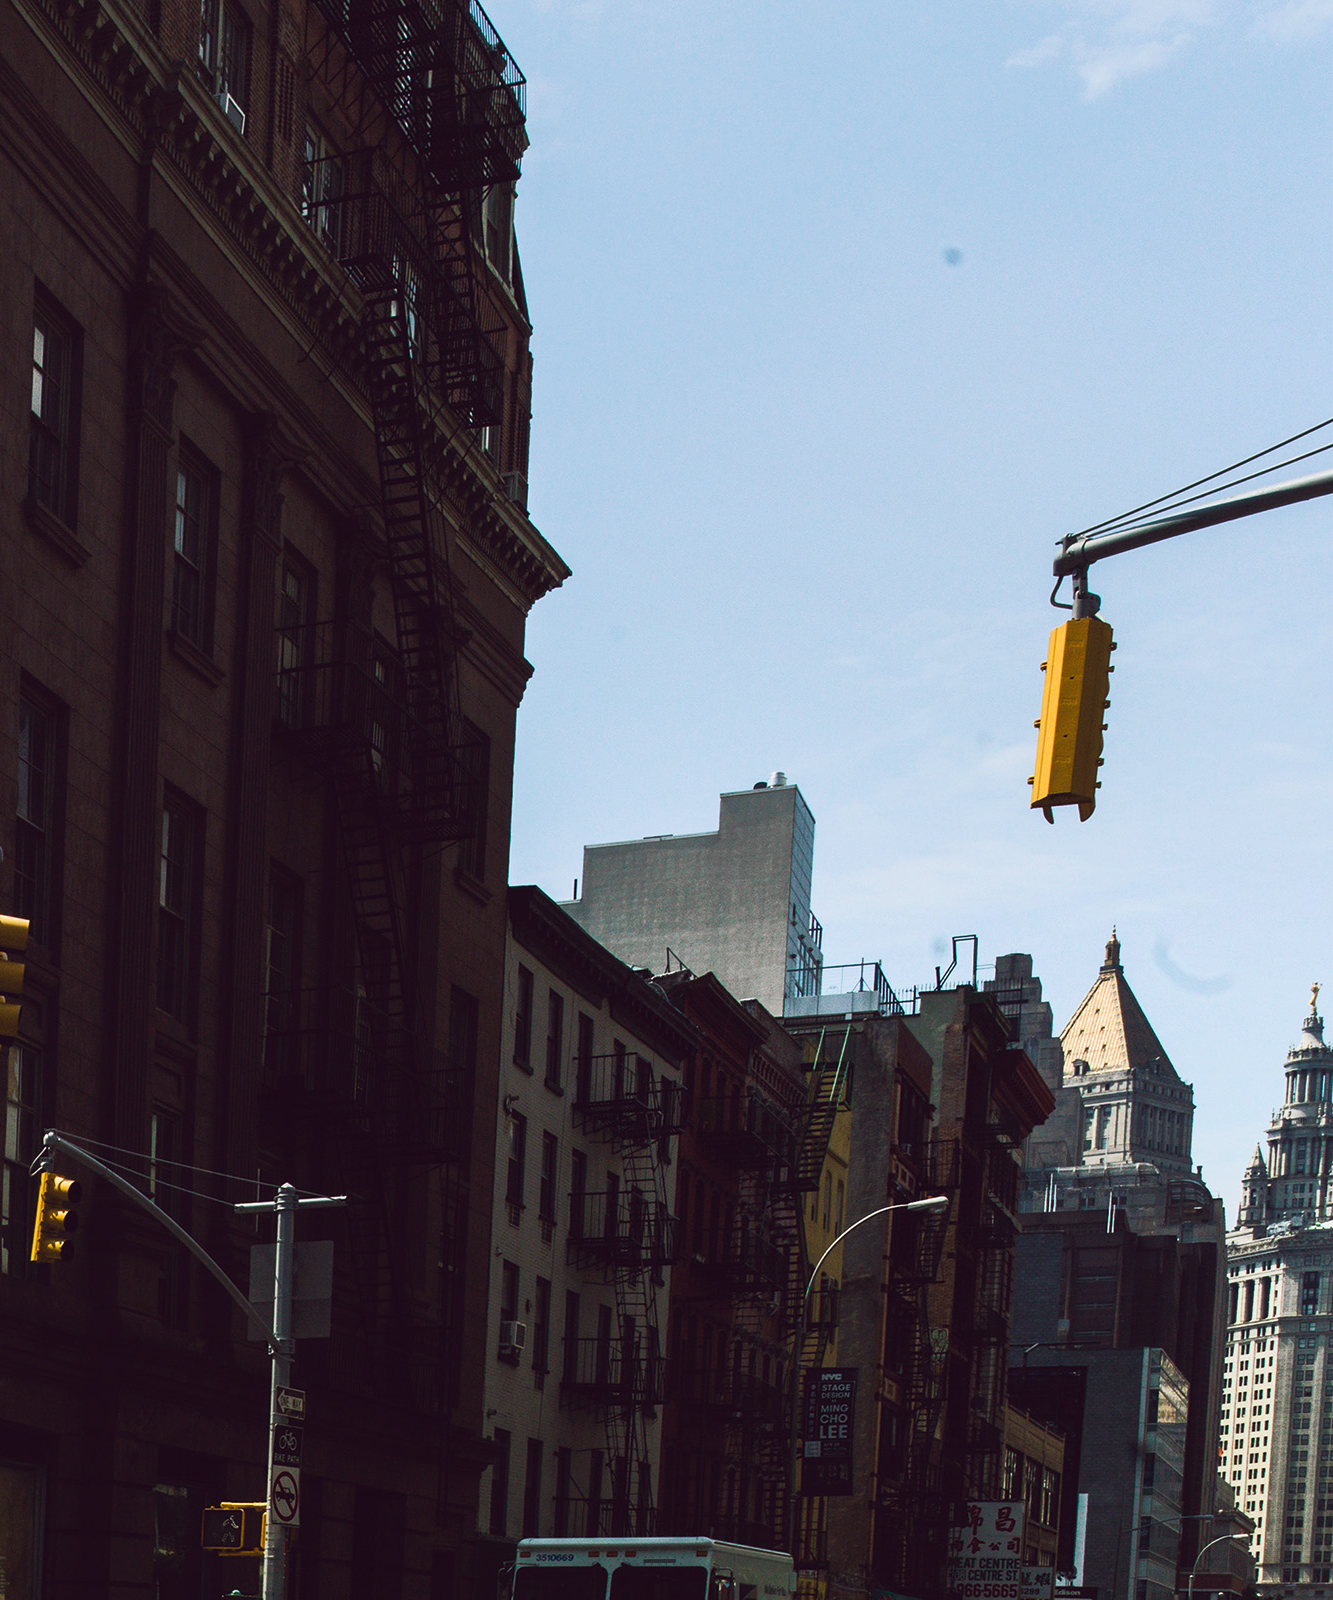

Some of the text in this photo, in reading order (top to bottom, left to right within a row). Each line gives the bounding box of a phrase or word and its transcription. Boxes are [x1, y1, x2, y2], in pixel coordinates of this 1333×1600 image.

[821, 1373, 843, 1381] NYC
[821, 1391, 850, 1399] DESIGN
[820, 1404, 849, 1412] MING
[819, 1413, 848, 1424] CHO
[819, 1424, 848, 1439] LEE
[274, 1452, 300, 1465] BIKE PATH
[536, 1553, 574, 1562] 3510669
[979, 1558, 1021, 1570] CENTRE
[968, 1570, 1003, 1582] CENTRE
[1006, 1570, 1019, 1581] ST.
